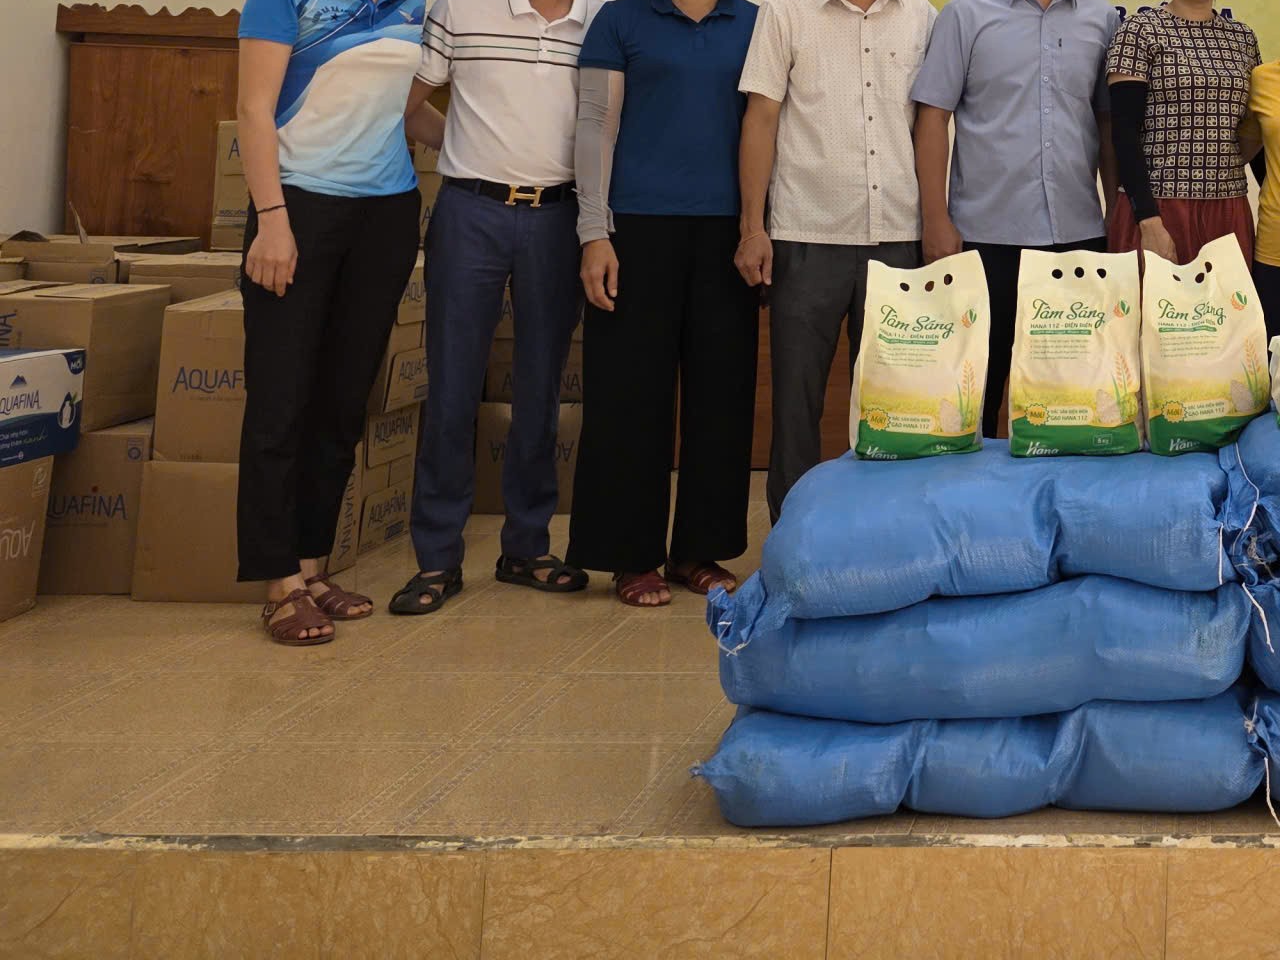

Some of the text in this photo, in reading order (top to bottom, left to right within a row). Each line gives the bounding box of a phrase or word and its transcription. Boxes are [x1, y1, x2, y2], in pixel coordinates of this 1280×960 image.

[880, 304, 954, 339] Tâm Sáng
[1032, 298, 1105, 328] Tâm Sáng
[1158, 298, 1226, 326] Tâm Sáng
[172, 366, 244, 394] AQUAF
[0, 390, 43, 416] QUAFINA
[47, 487, 128, 520] UAFINA
